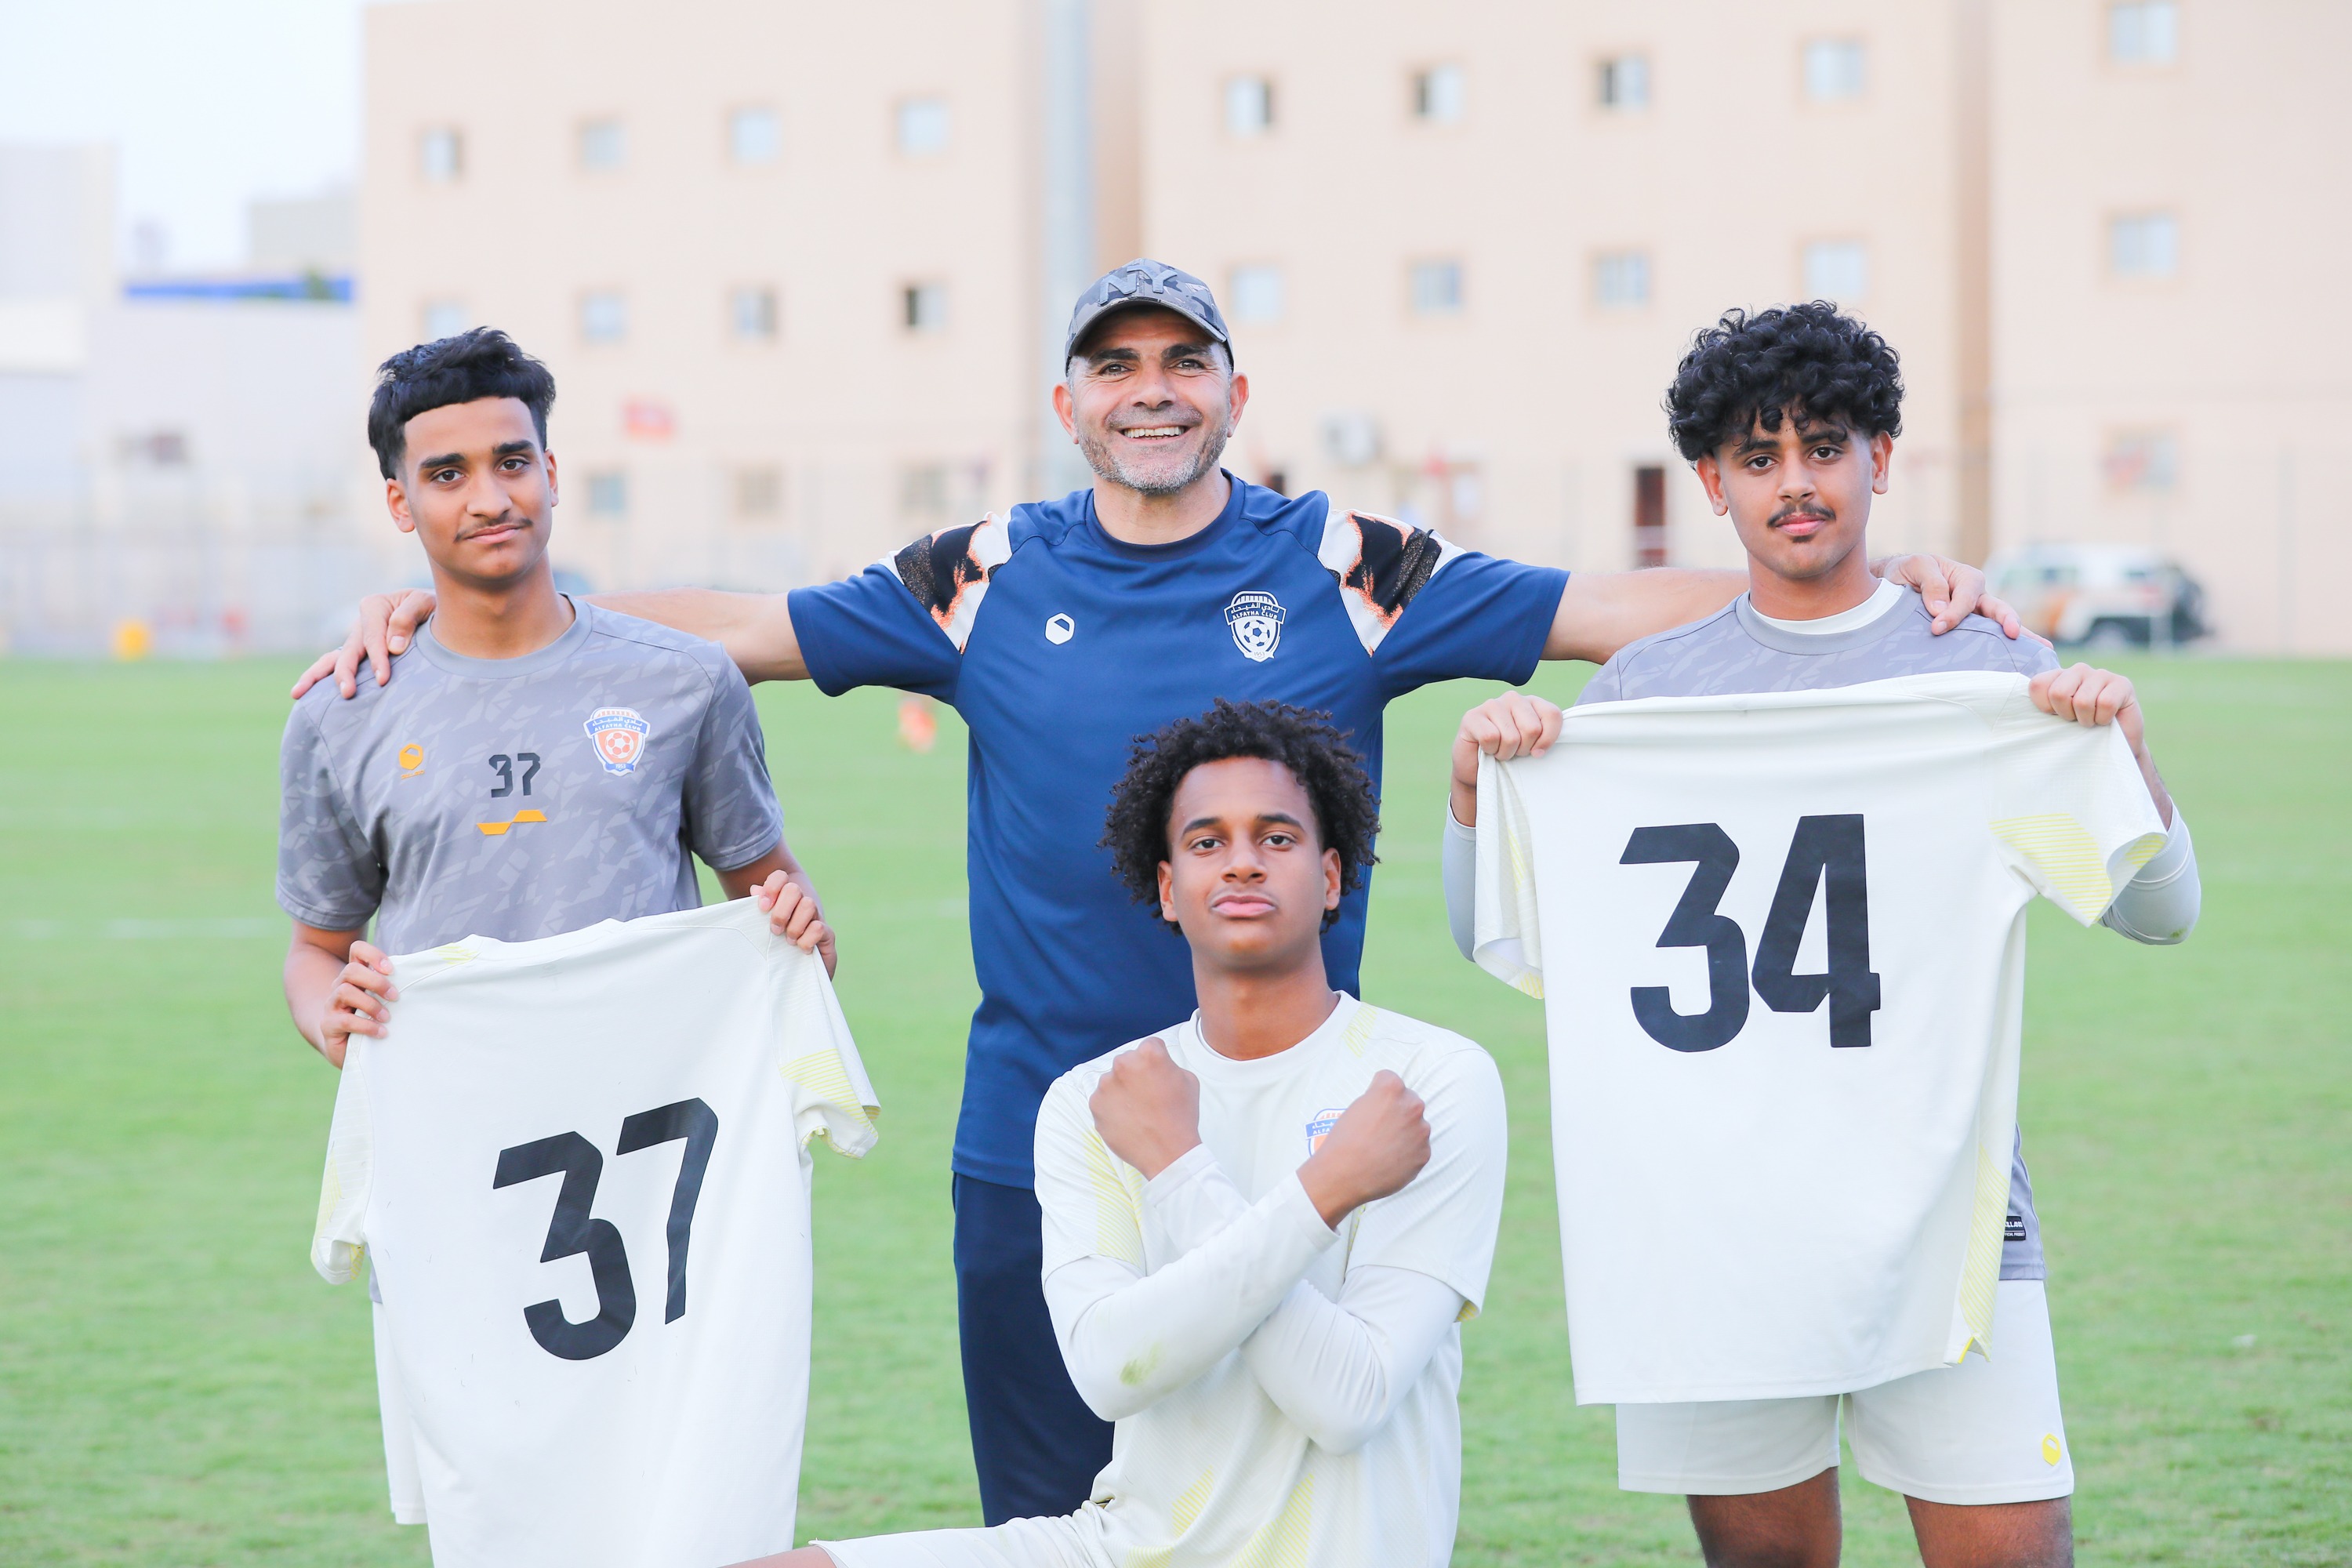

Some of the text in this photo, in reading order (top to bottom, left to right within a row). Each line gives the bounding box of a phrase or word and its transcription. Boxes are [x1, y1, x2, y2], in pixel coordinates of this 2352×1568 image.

[1098, 265, 1178, 306] NY
[1231, 602, 1279, 614] نادي الفيحاء
[1232, 611, 1259, 620] ALFAYHA
[594, 723, 641, 732] ALFAYHA CLUB
[488, 752, 541, 798] 37
[1619, 813, 1881, 1053] 34
[492, 1097, 719, 1361] 37
